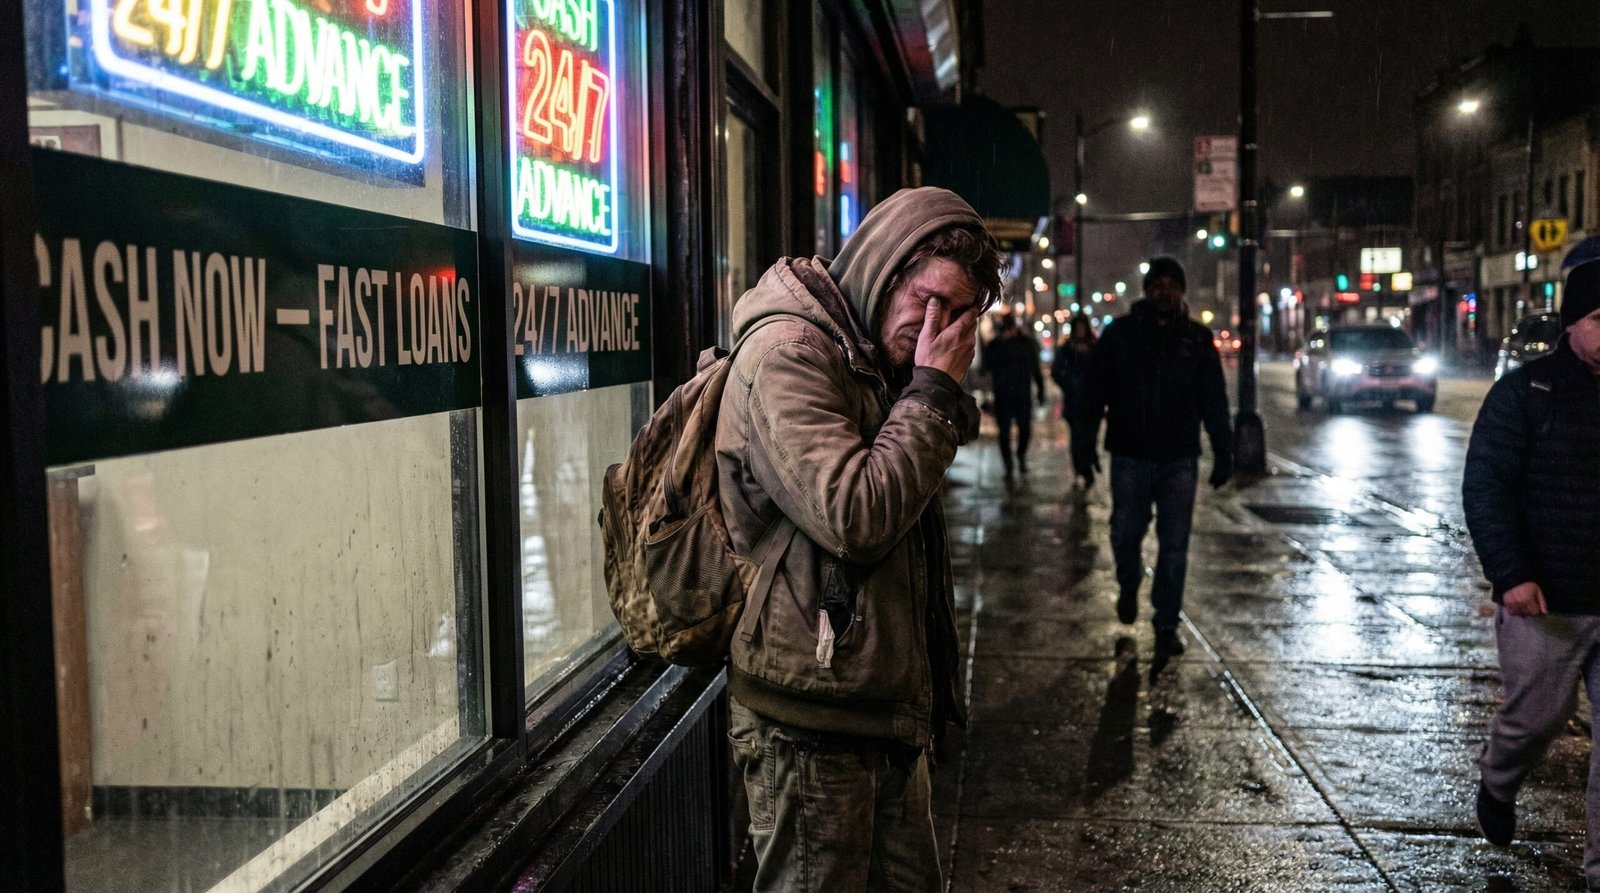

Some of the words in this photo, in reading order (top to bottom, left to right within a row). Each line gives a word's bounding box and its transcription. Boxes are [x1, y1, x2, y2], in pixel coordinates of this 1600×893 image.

[241, 0, 411, 136] ADVANCE
[524, 29, 609, 163] 24/7
[517, 156, 611, 237] ADVANCE
[173, 249, 267, 377] NOW
[317, 263, 389, 370] FAST
[395, 271, 471, 367] LOANS
[513, 282, 560, 356] 24/7
[566, 287, 640, 354] ADVANCE
